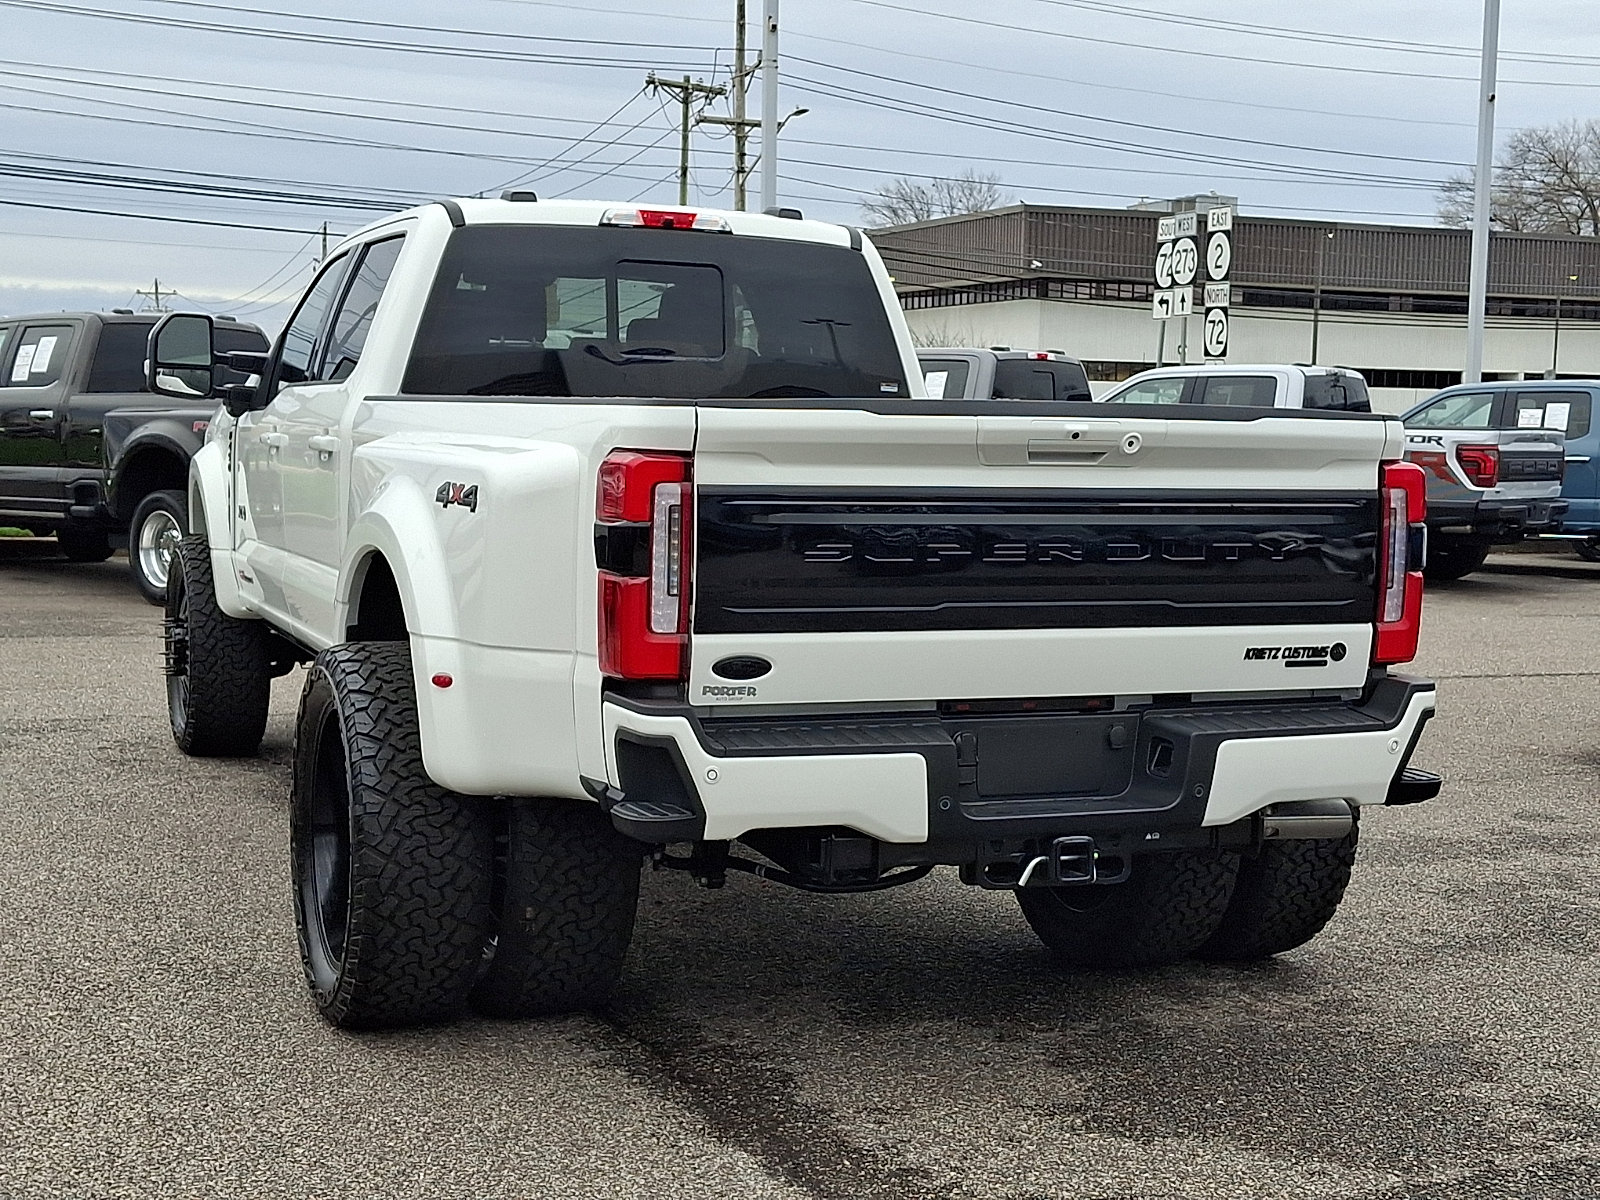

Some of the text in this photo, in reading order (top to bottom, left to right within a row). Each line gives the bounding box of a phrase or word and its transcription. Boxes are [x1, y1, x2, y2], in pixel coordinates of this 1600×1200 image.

[1178, 217, 1194, 232] WEST
[1211, 212, 1228, 227] EAST
[1174, 248, 1196, 275] 273
[1214, 243, 1224, 269] 2
[1206, 287, 1228, 304] NORTH
[1208, 319, 1225, 346] 72
[803, 540, 1300, 562] SUPER DUTY
[1281, 646, 1330, 660] CUSTOMS
[702, 685, 758, 697] PORTER
